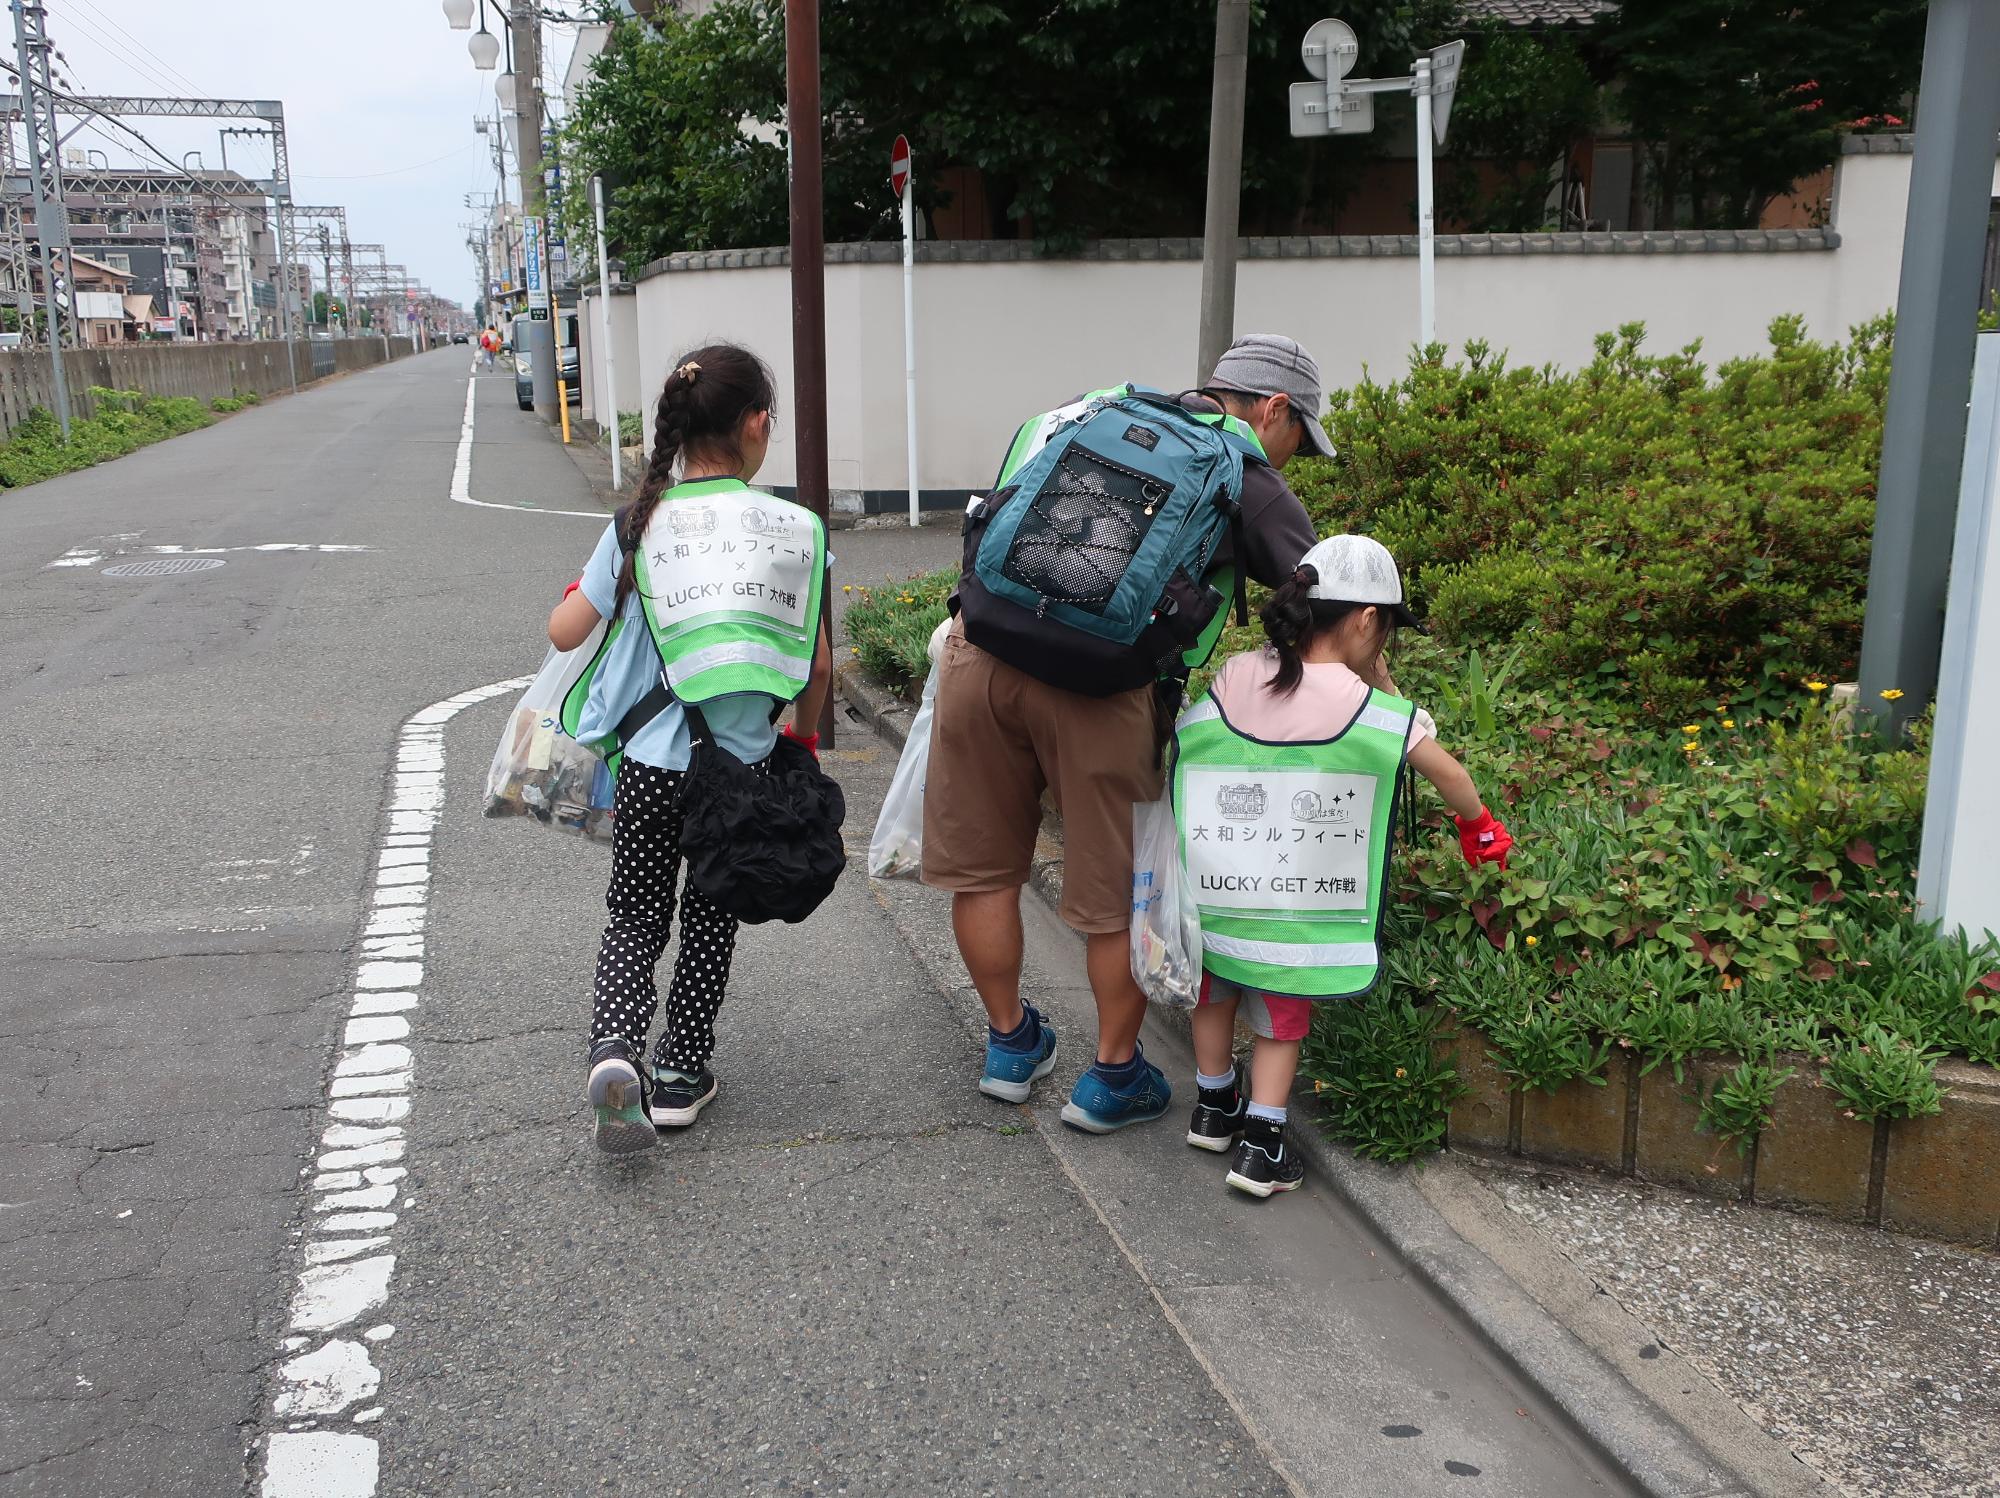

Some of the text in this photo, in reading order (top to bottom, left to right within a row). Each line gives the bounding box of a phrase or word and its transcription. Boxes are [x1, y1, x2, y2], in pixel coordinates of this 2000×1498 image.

[652, 539, 811, 568] 大和シルフィード
[666, 582, 797, 610] LUCKY GET 大作戦
[1192, 825, 1366, 845] 大和シルフィード
[1200, 875, 1357, 895] LUCKY GET 大作戦
